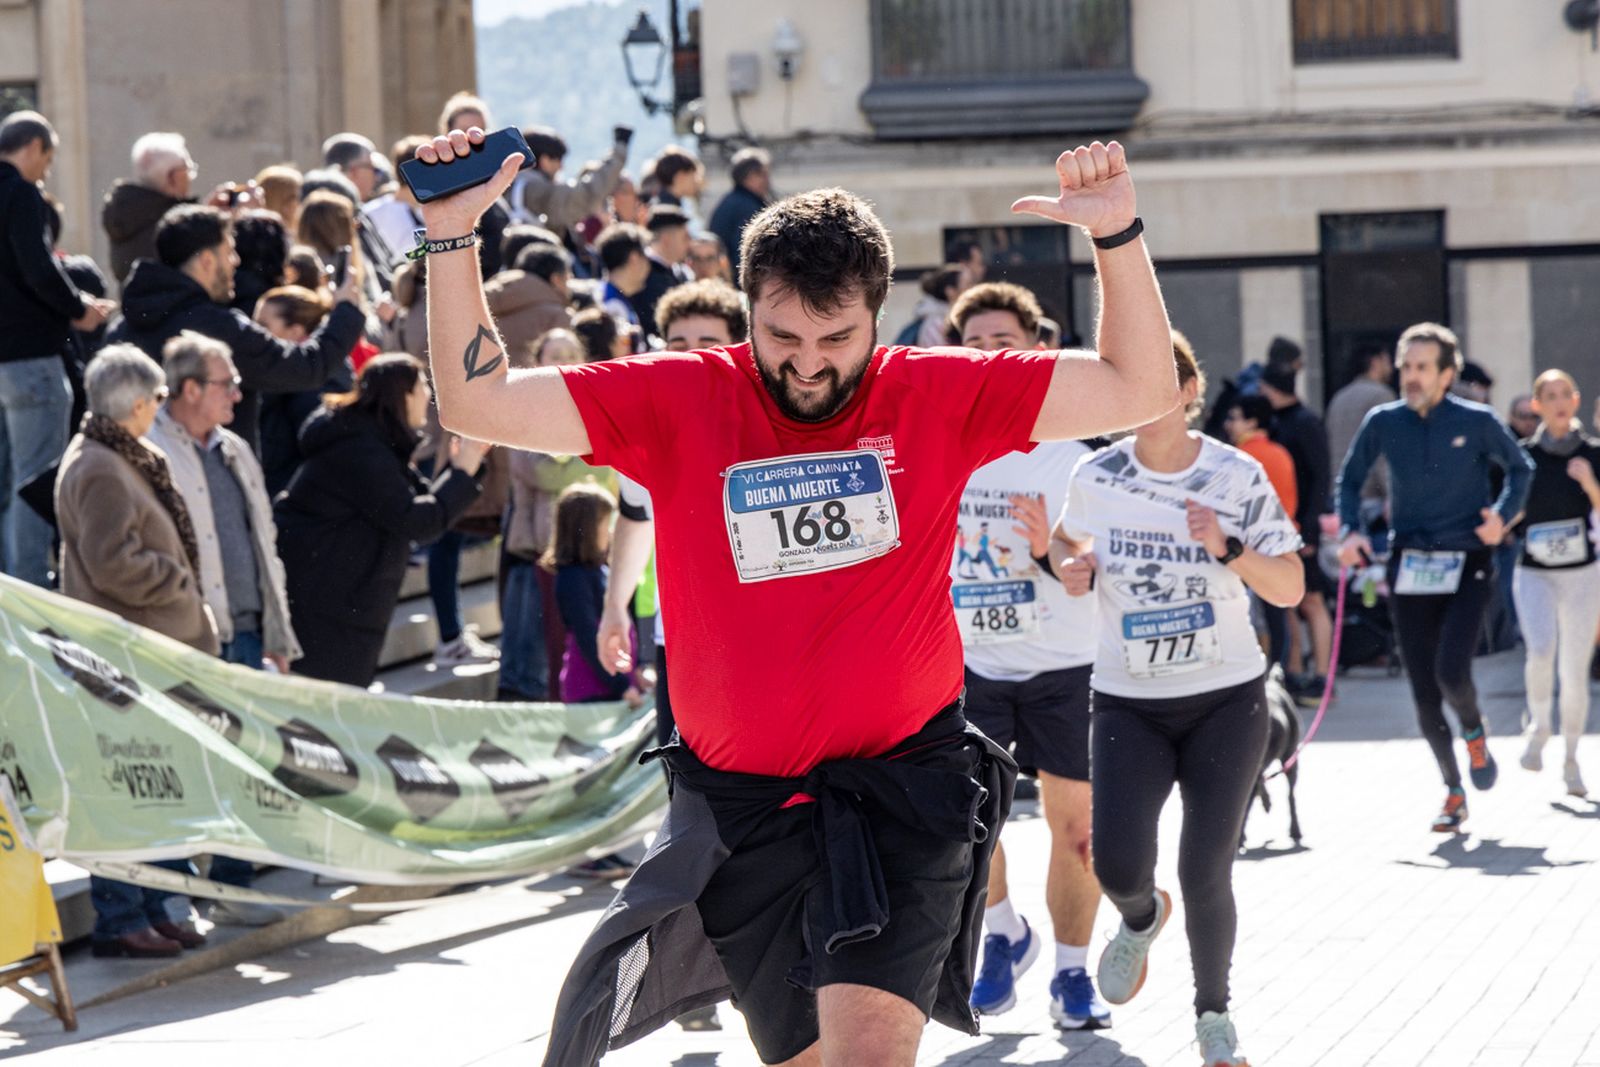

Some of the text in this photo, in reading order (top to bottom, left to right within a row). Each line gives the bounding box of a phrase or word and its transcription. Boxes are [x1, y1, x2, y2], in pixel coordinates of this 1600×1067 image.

[429, 241, 453, 252] SOY
[744, 460, 862, 484] VI CARRERA CAMINATA
[745, 478, 841, 507] BUENA MUERTE
[770, 500, 850, 549] 168
[1124, 530, 1175, 543] CARRERA
[778, 547, 811, 558] GONZALO
[1109, 540, 1212, 564] URBANA
[972, 605, 1019, 631] 488
[1145, 633, 1197, 664] 777
[121, 763, 184, 799] VERDAD
